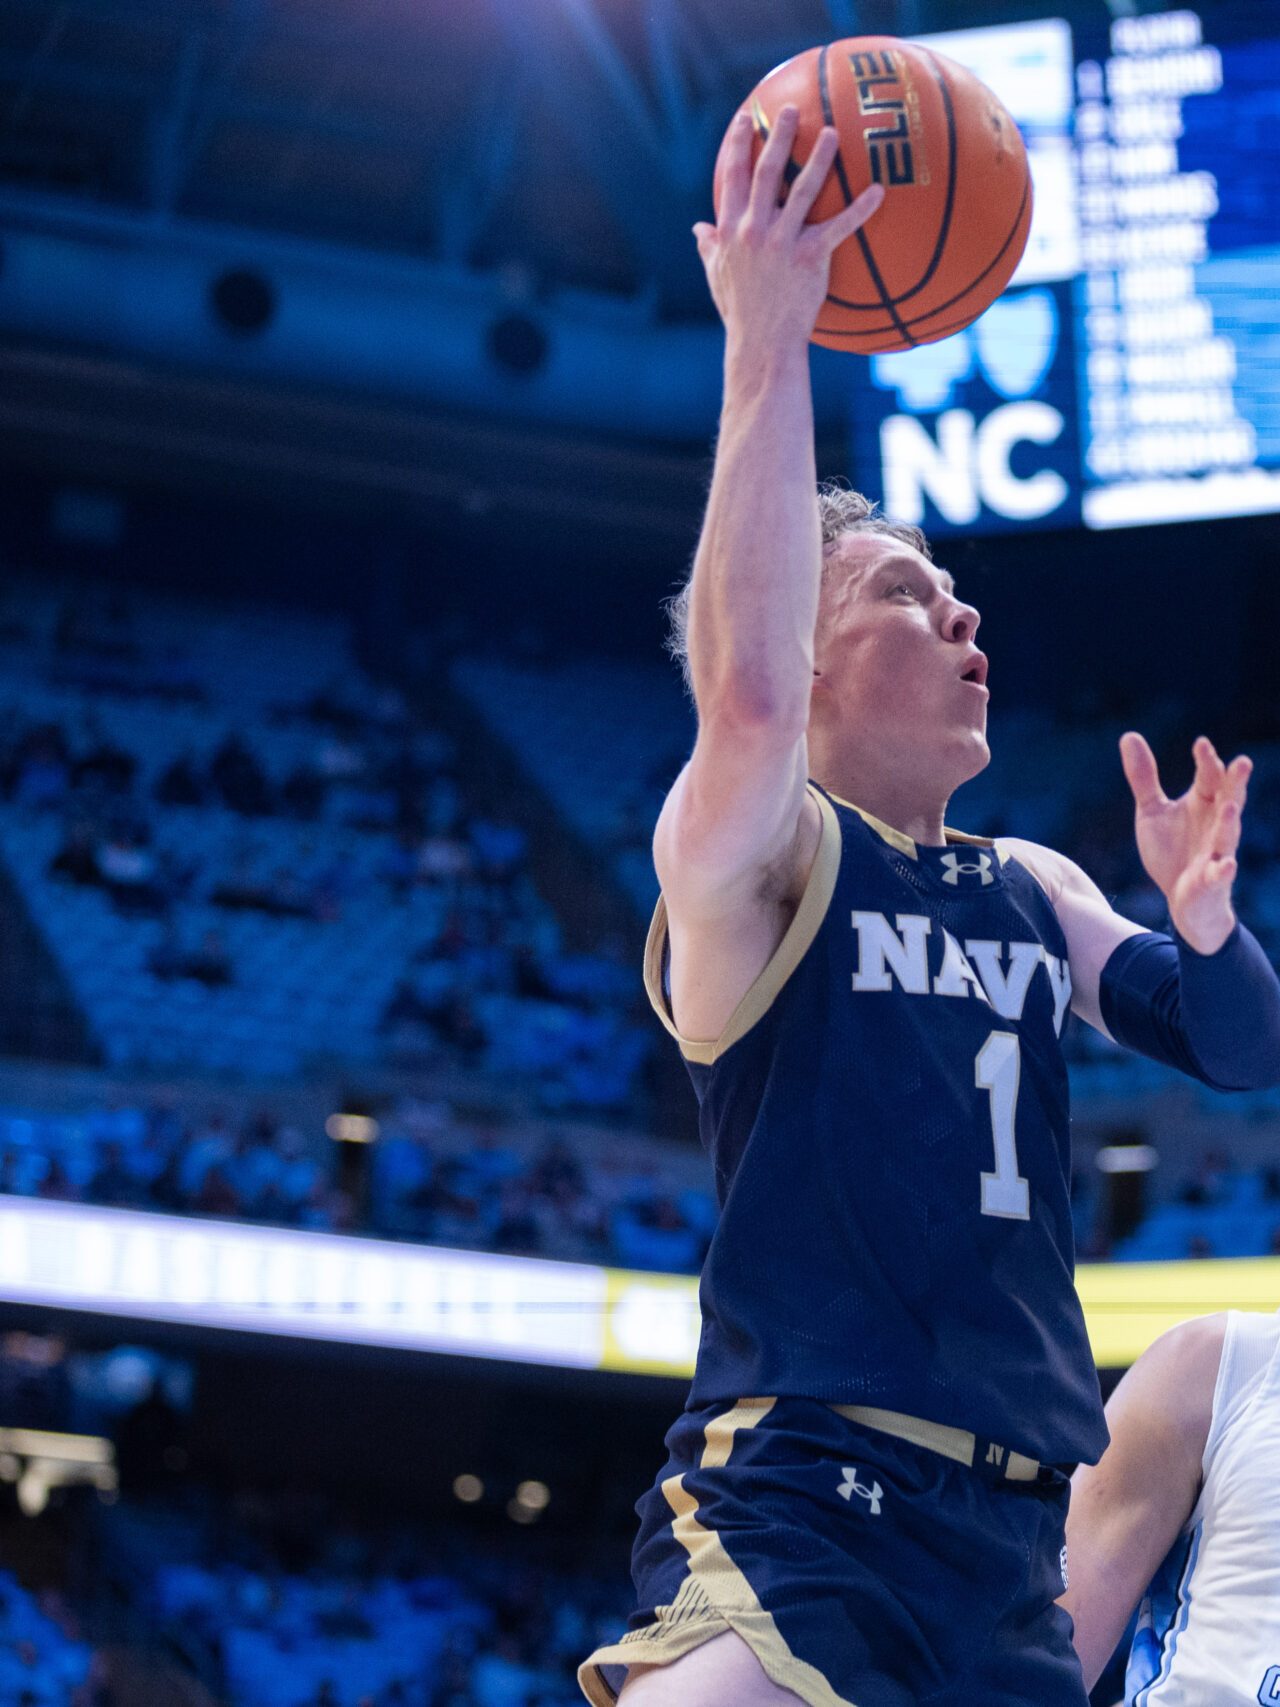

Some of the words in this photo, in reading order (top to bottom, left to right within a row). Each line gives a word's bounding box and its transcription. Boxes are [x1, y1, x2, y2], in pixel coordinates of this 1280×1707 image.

[880, 400, 1069, 526] NC
[851, 910, 1073, 1039] NAVY
[974, 1030, 1030, 1221] 1
